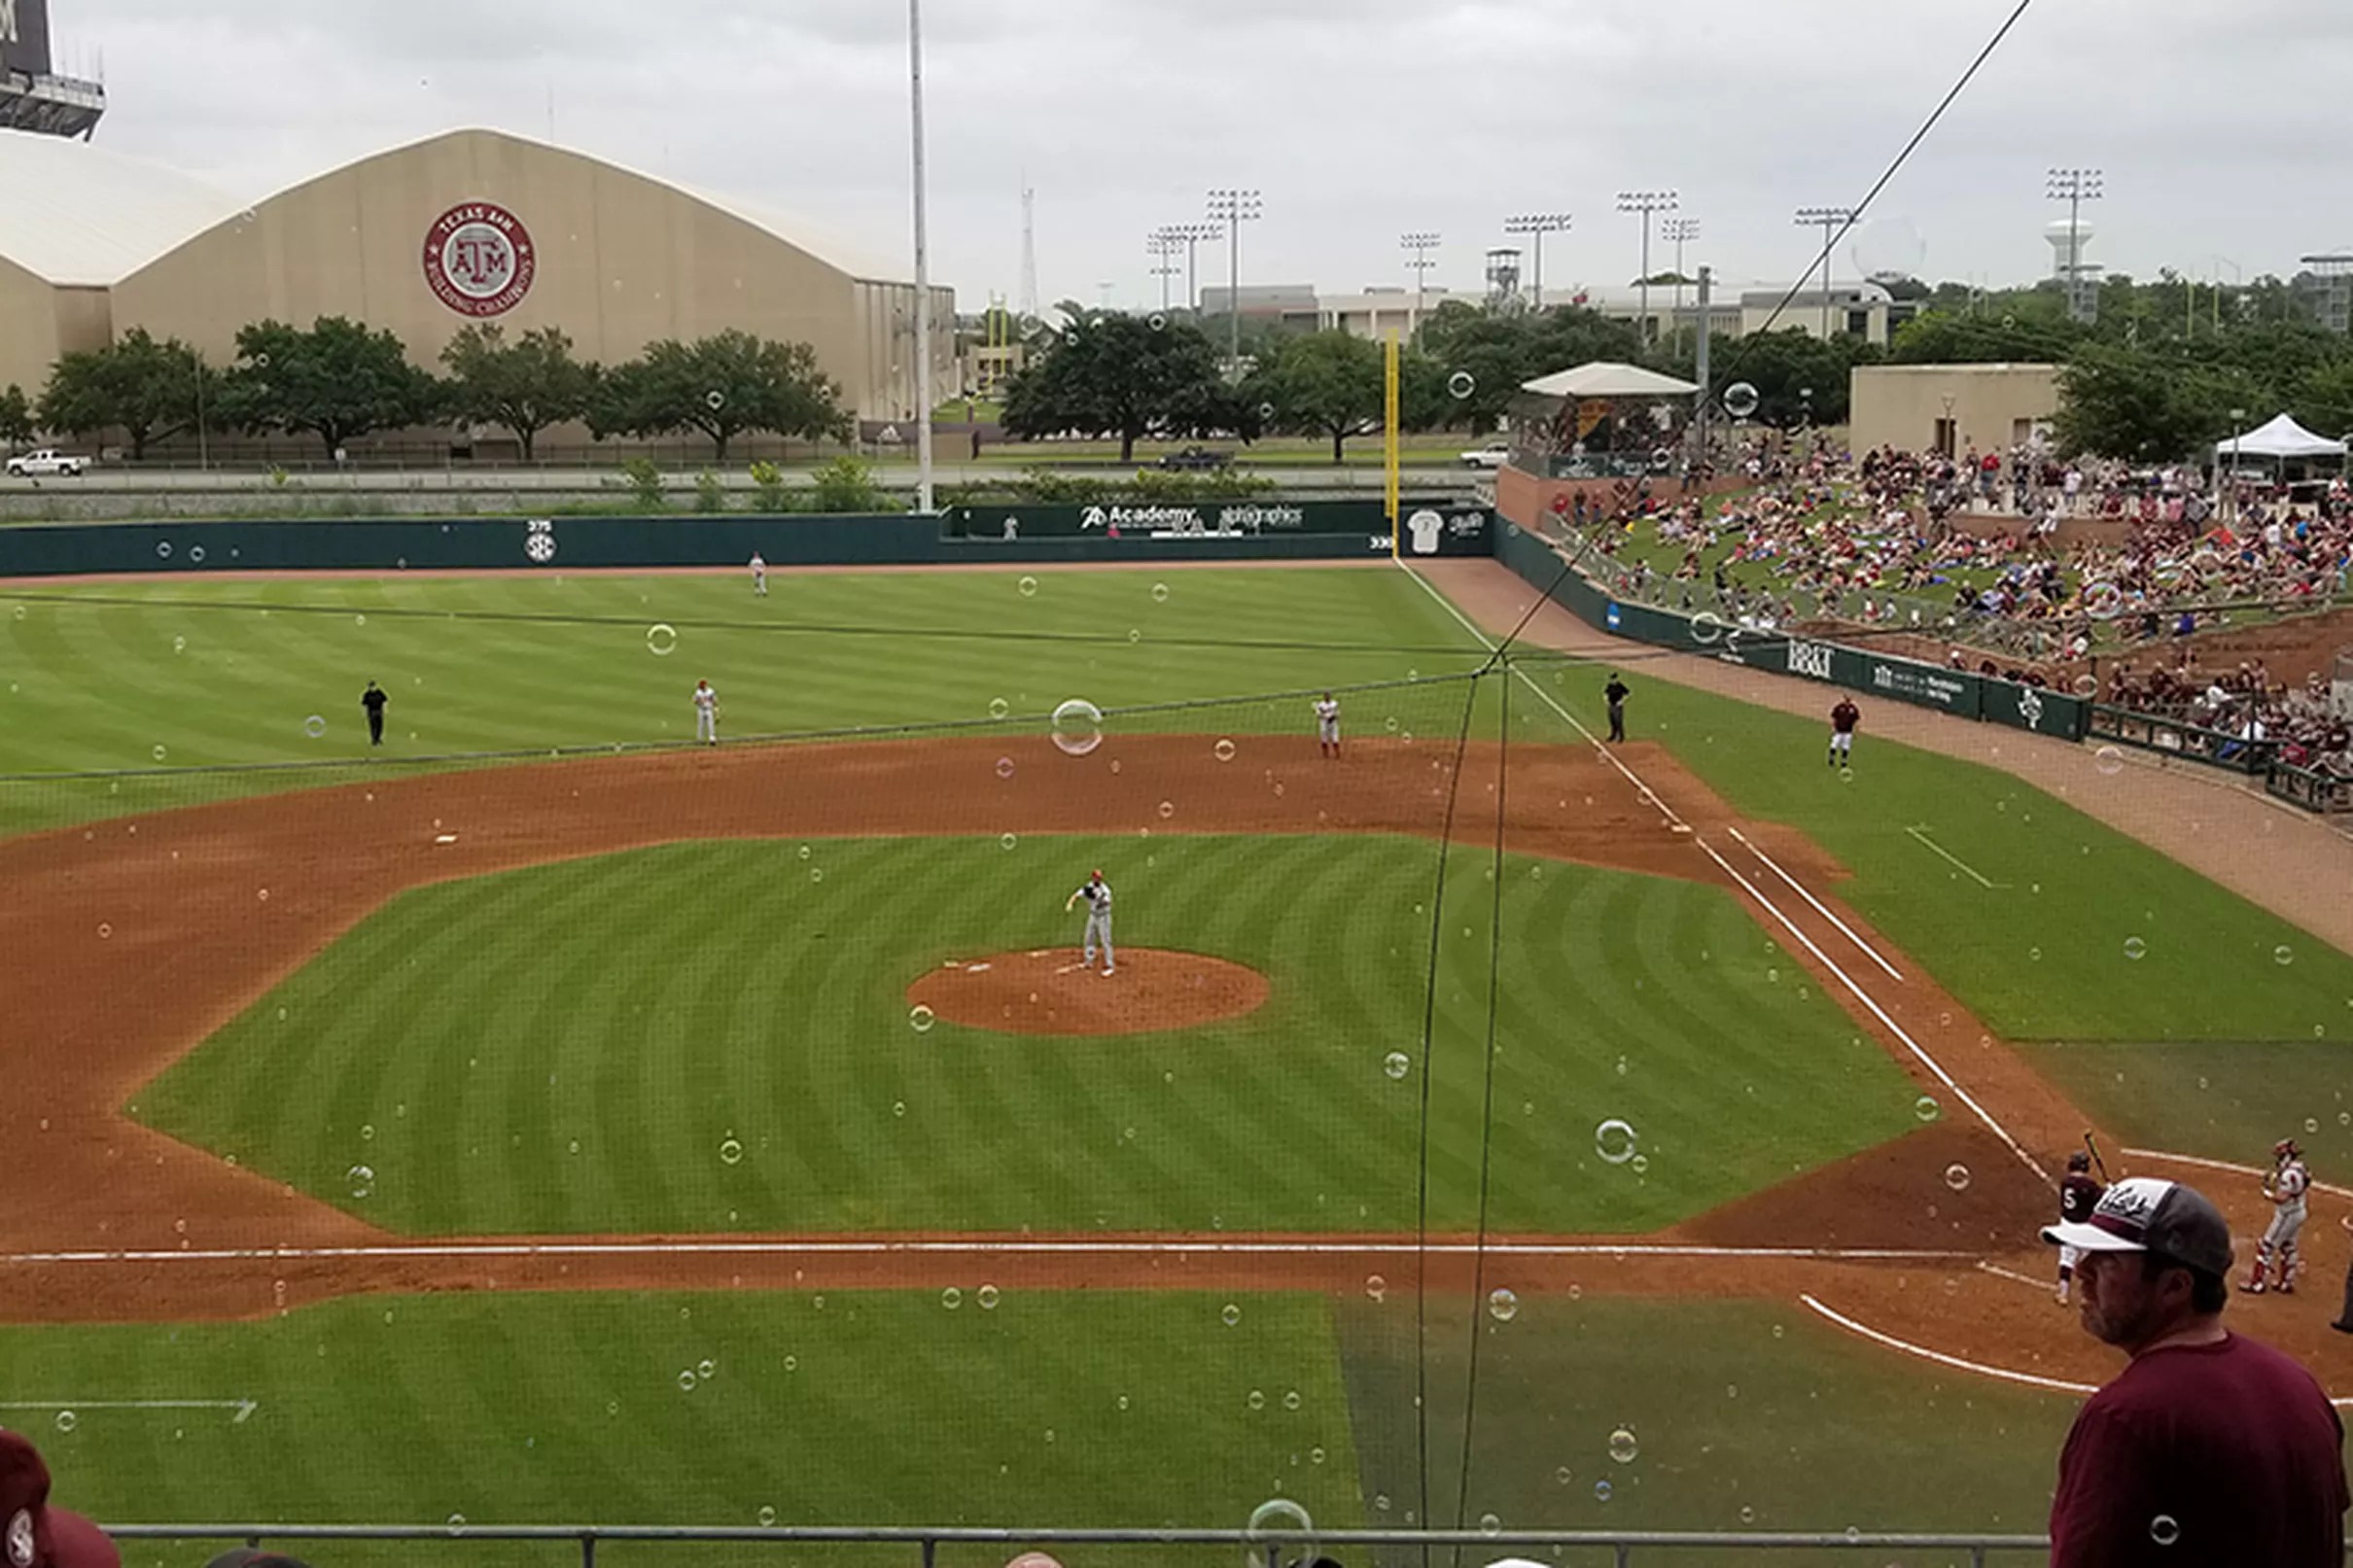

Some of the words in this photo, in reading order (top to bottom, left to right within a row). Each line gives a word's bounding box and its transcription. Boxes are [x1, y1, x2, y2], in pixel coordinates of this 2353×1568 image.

[439, 207, 484, 232] TEXAS
[1109, 505, 1196, 524] Academy
[1788, 639, 1836, 679] BB&T
